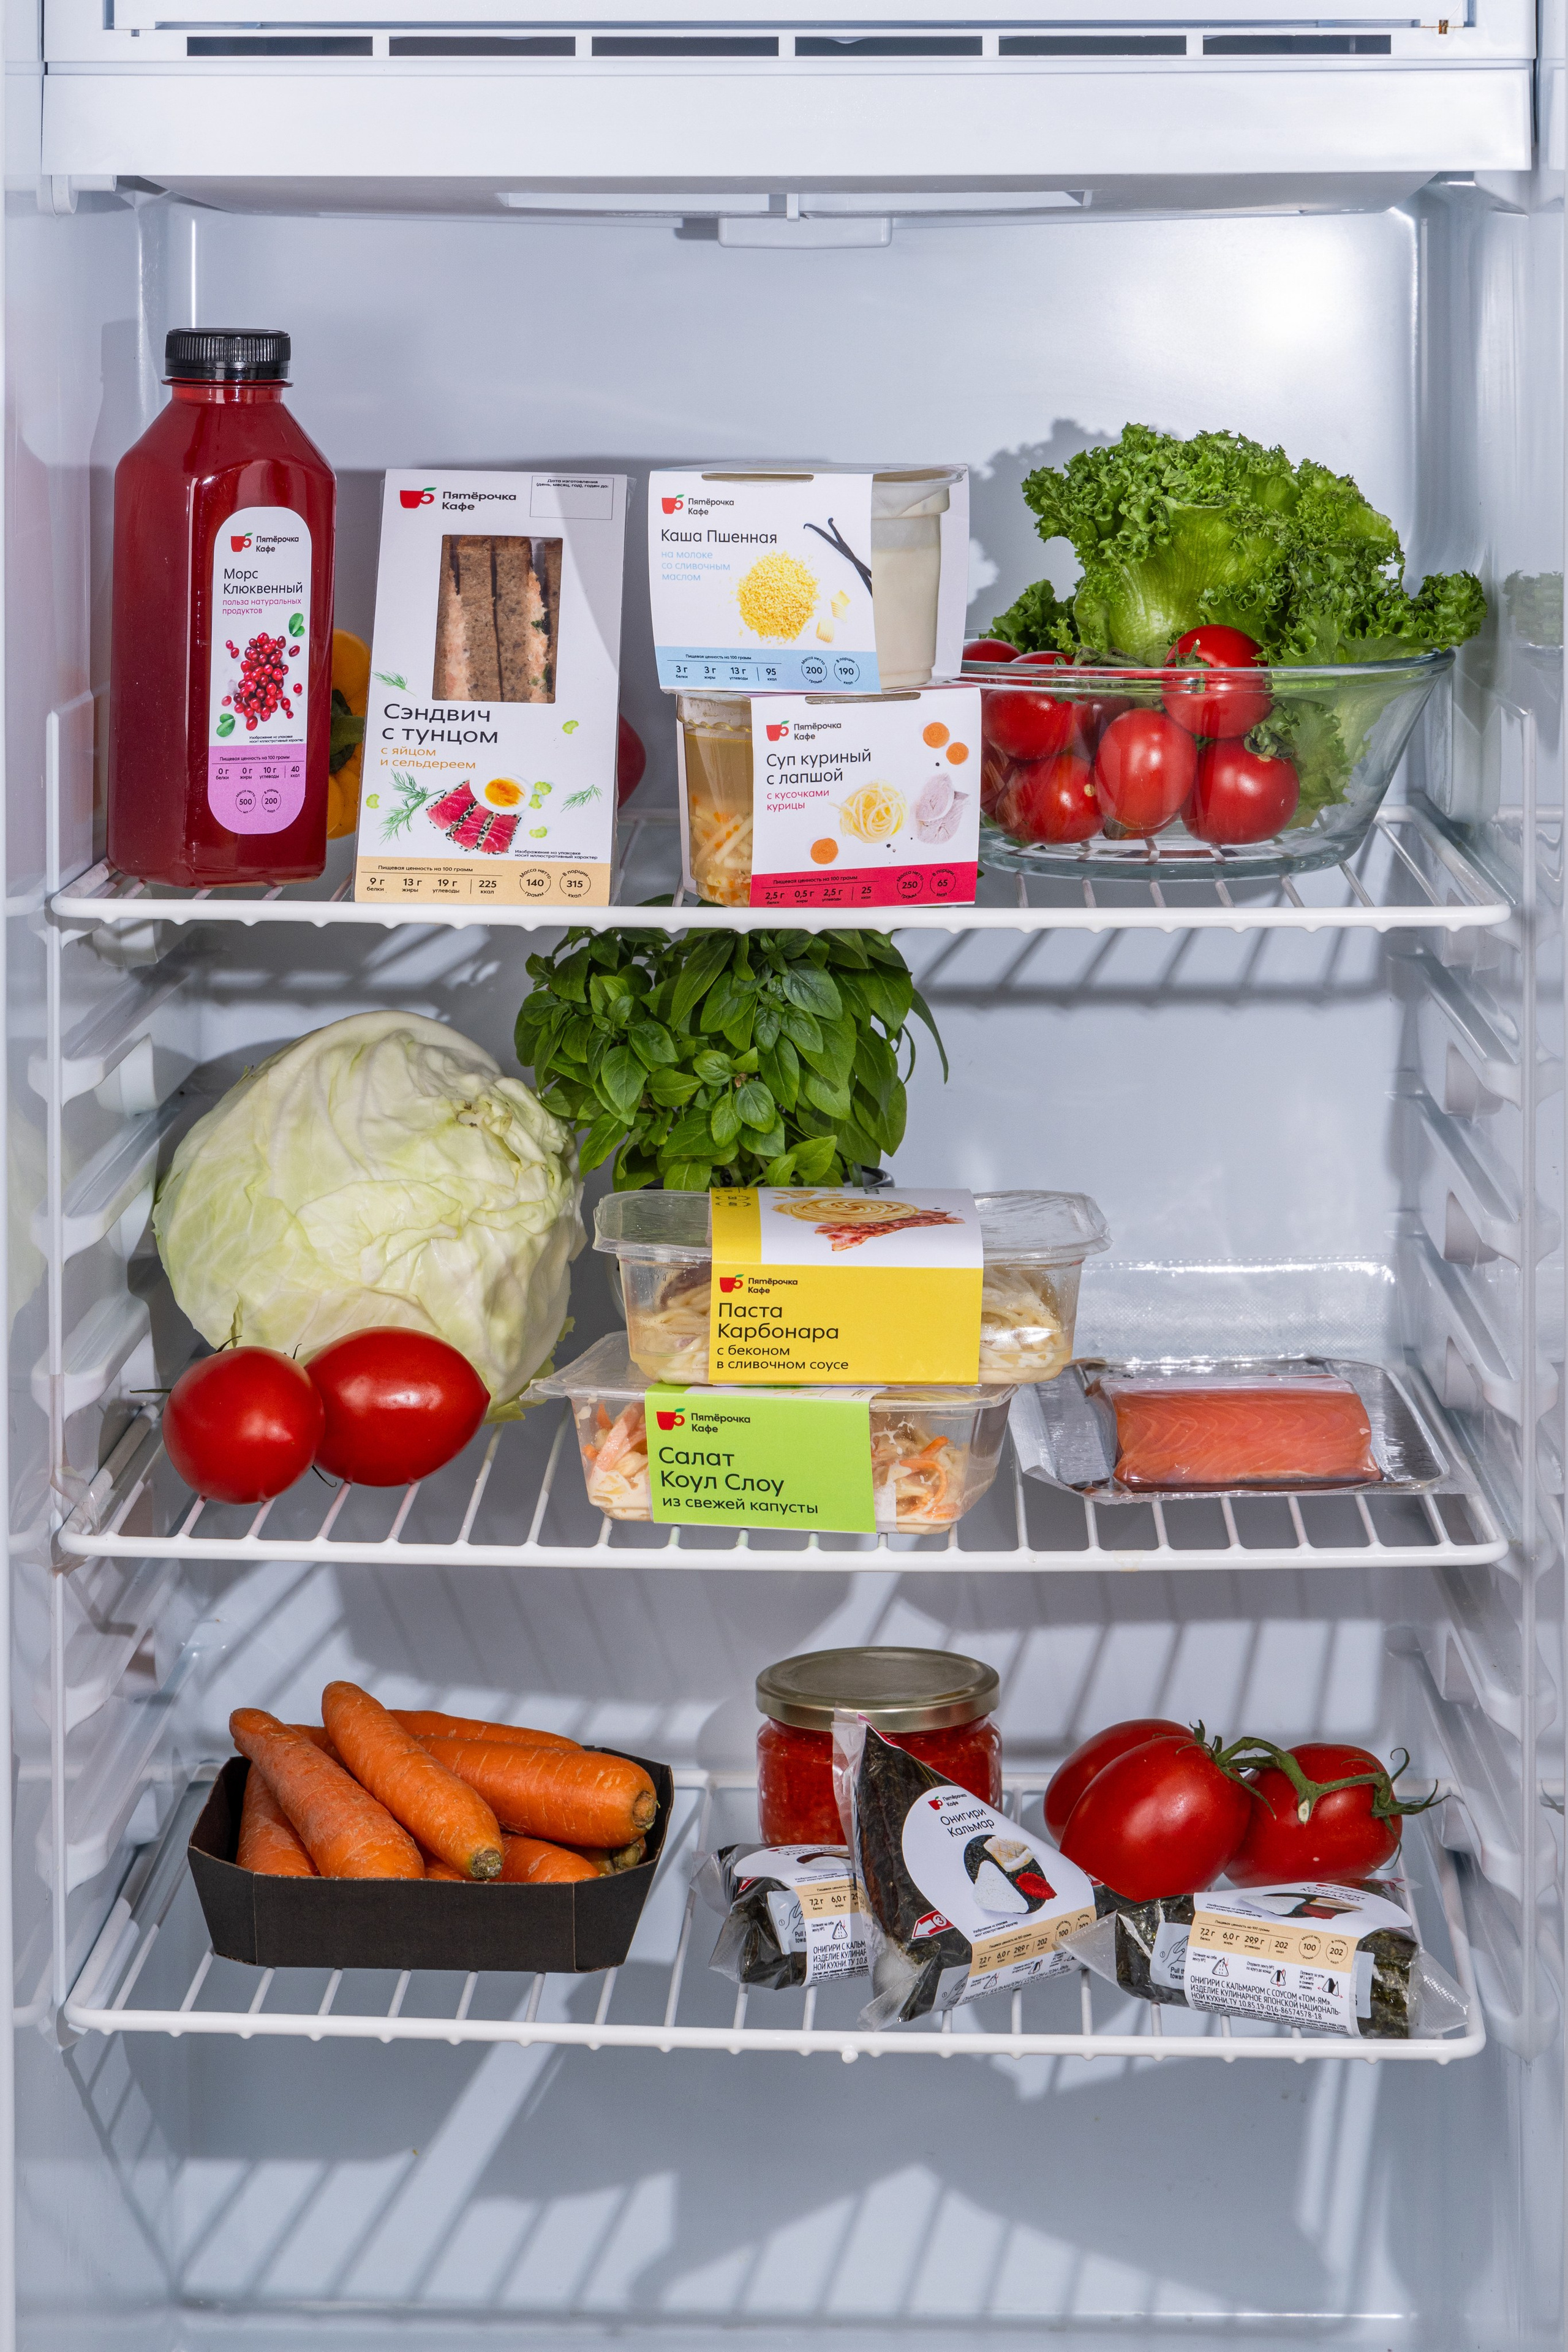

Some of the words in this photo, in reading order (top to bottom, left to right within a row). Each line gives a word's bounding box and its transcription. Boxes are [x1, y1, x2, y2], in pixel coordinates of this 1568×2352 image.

[442, 491, 517, 501] Пятёрочка
[442, 502, 475, 512] Кафе
[688, 497, 734, 508] Пятёрочка
[688, 508, 709, 516] Кафе
[256, 535, 299, 544] Пятёрочка
[661, 529, 702, 543] Каша
[707, 529, 777, 544] Пшенная
[256, 545, 276, 554] Кафе
[676, 551, 713, 559] молоке
[675, 562, 730, 571] сливочным
[224, 568, 258, 582] Морс
[224, 582, 303, 594] Клюквенный
[383, 704, 491, 723] Сэндвич
[794, 722, 842, 732] Пятёрочка
[382, 728, 394, 739] с
[402, 729, 498, 745] тунцом
[794, 733, 816, 742] Кафе
[392, 745, 436, 757] яйцом
[392, 759, 476, 770] сельдереем
[767, 753, 796, 770] Суп
[801, 749, 871, 767] куриный
[767, 775, 774, 785] с
[779, 768, 843, 785] лапшой
[775, 790, 829, 801] кусочками
[767, 802, 805, 812] курицы
[902, 881, 918, 889] 250
[766, 892, 778, 900] 2,5
[748, 1276, 798, 1286] Пятёрочка
[748, 1286, 771, 1295] Кафе
[718, 1303, 783, 1318] Паста
[717, 1322, 839, 1342] Карбонара
[728, 1344, 790, 1356] беконом
[727, 1361, 806, 1370] сливочном
[809, 1361, 849, 1371] соусе
[691, 1412, 751, 1423] Пятёрочка
[692, 1424, 718, 1434] Кафе
[658, 1447, 735, 1467] Салат
[660, 1470, 718, 1493] Коул
[725, 1473, 785, 1496] Слоу
[663, 1498, 681, 1507] из
[685, 1498, 745, 1510] свежей
[750, 1501, 818, 1515] капусты
[940, 1809, 987, 1826] Онигири
[947, 1819, 995, 1838] Кальмар
[1300, 1888, 1360, 1902] Кальмар
[1306, 1886, 1366, 1900] Онигири
[1058, 1929, 1069, 1937] 100
[1037, 1938, 1048, 1947] 202
[1244, 1936, 1259, 1945] 29,9
[1303, 1943, 1316, 1951] 100
[1329, 1948, 1344, 1956] 202
[1190, 1975, 1220, 1988] ОНИГИРИ
[1226, 1981, 1265, 1995] КАЛЬМАРОМ
[1272, 1989, 1297, 2000] СОУСОМ
[1298, 1994, 1332, 2007] «ТОМ-ЯМ».
[1190, 1984, 1219, 1994] ИЗДЕЛИЕ
[1221, 1989, 1262, 2002] КУЛИНАРНОЕ
[1263, 1997, 1298, 2010] ЯПОНСКОЙ
[1299, 2003, 1341, 2016] НАЦИОНАЛЬ-
[1191, 1991, 1205, 2000] НОЙ
[1239, 2000, 1322, 2019] 10.85.19-016-86574578-18
